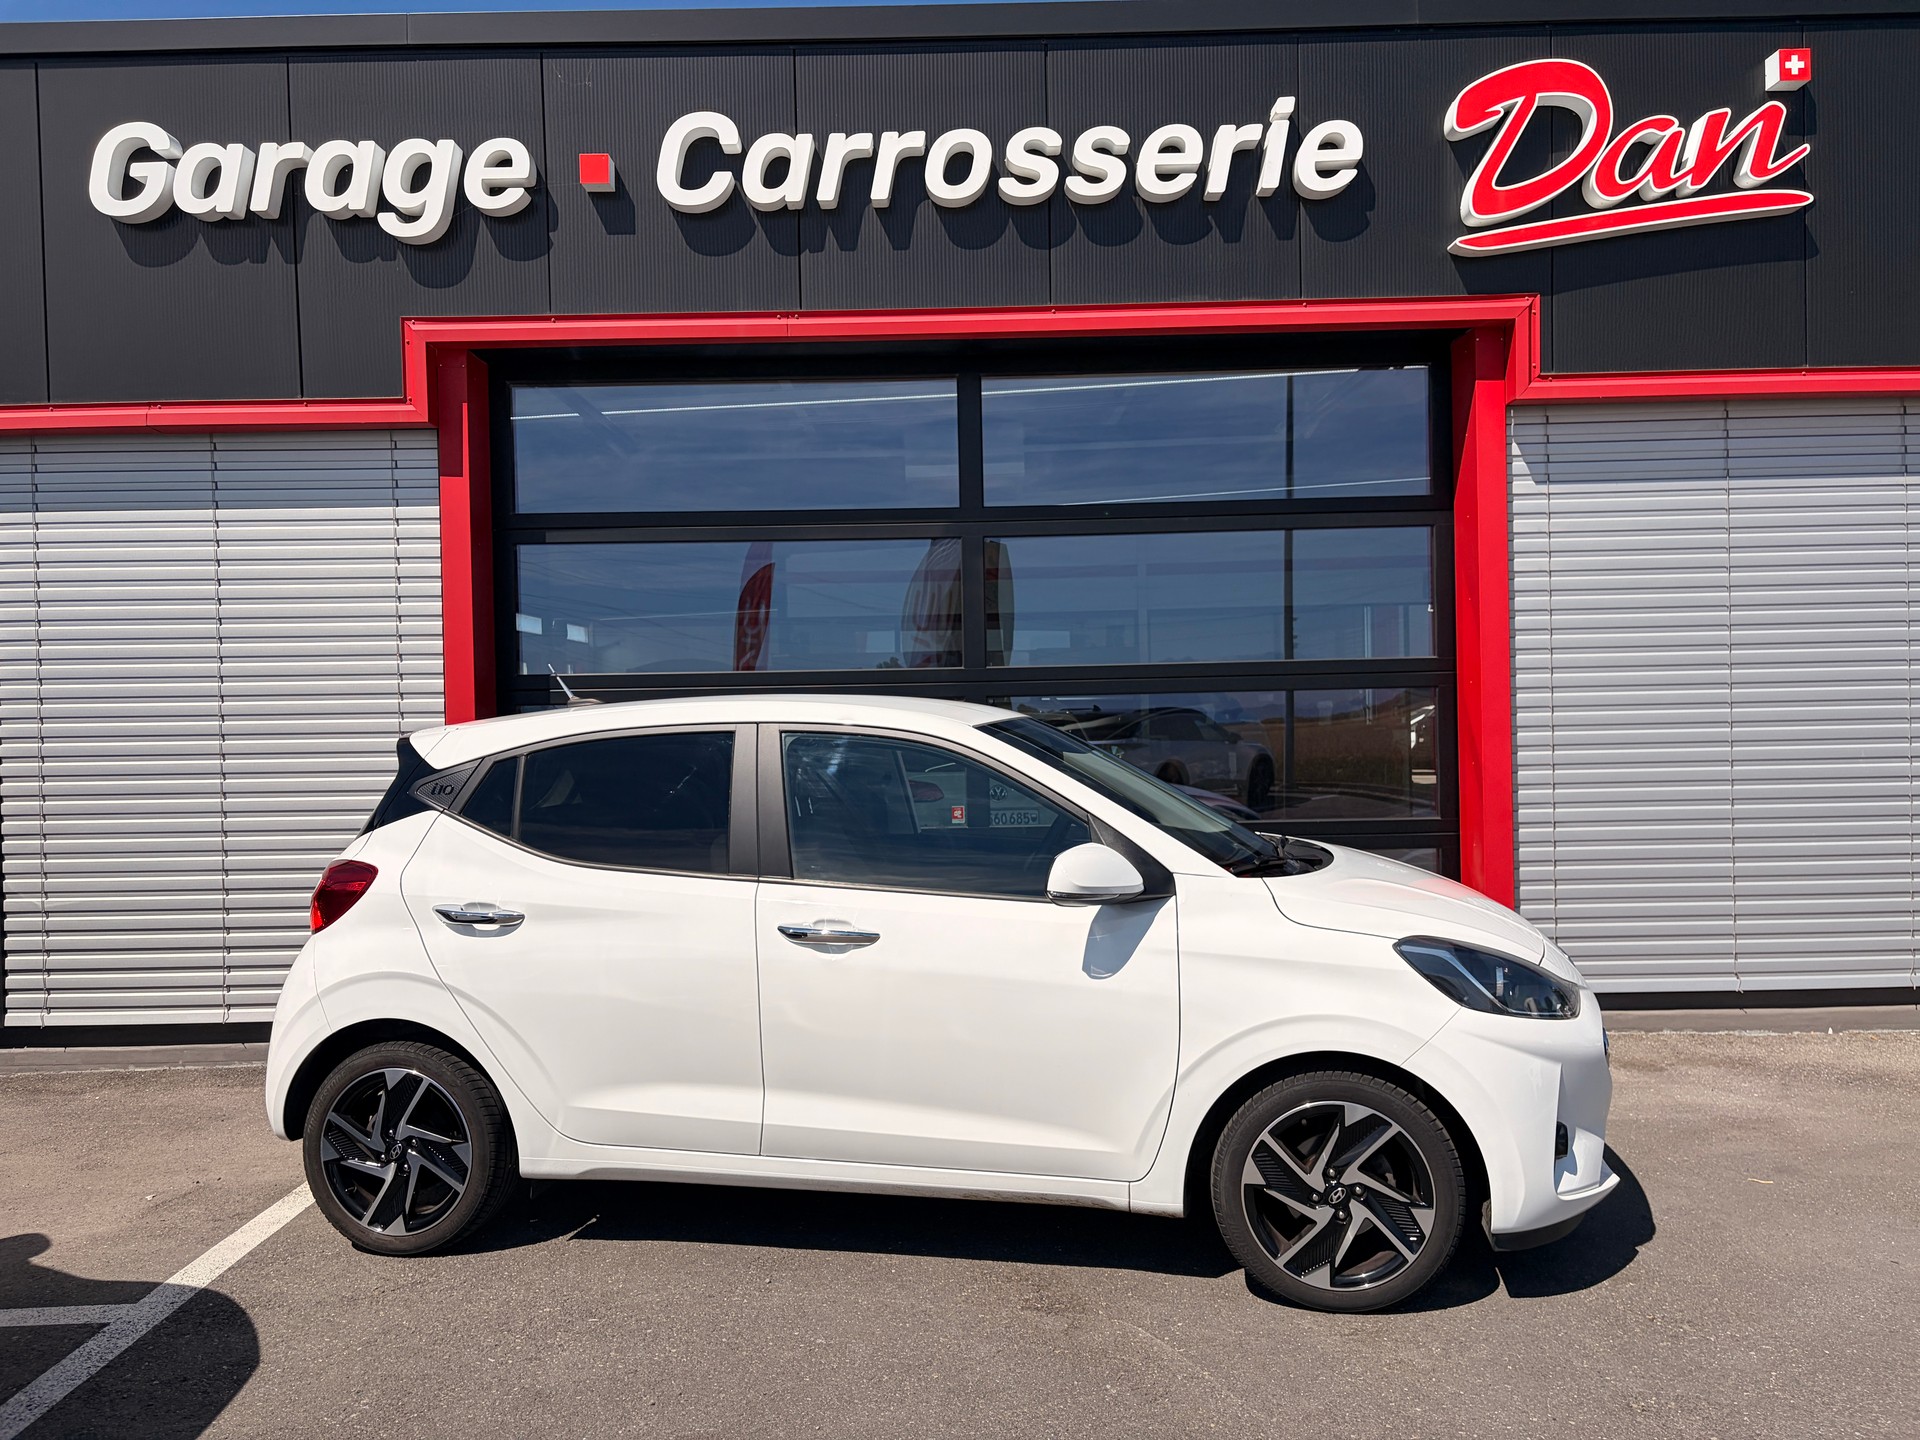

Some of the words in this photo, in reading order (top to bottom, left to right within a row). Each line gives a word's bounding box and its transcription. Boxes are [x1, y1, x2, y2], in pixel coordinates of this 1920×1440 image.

[89, 121, 537, 245] Garage
[656, 96, 1364, 214] Carrosserie
[431, 783, 454, 795] i10
[990, 812, 1007, 825] 60
